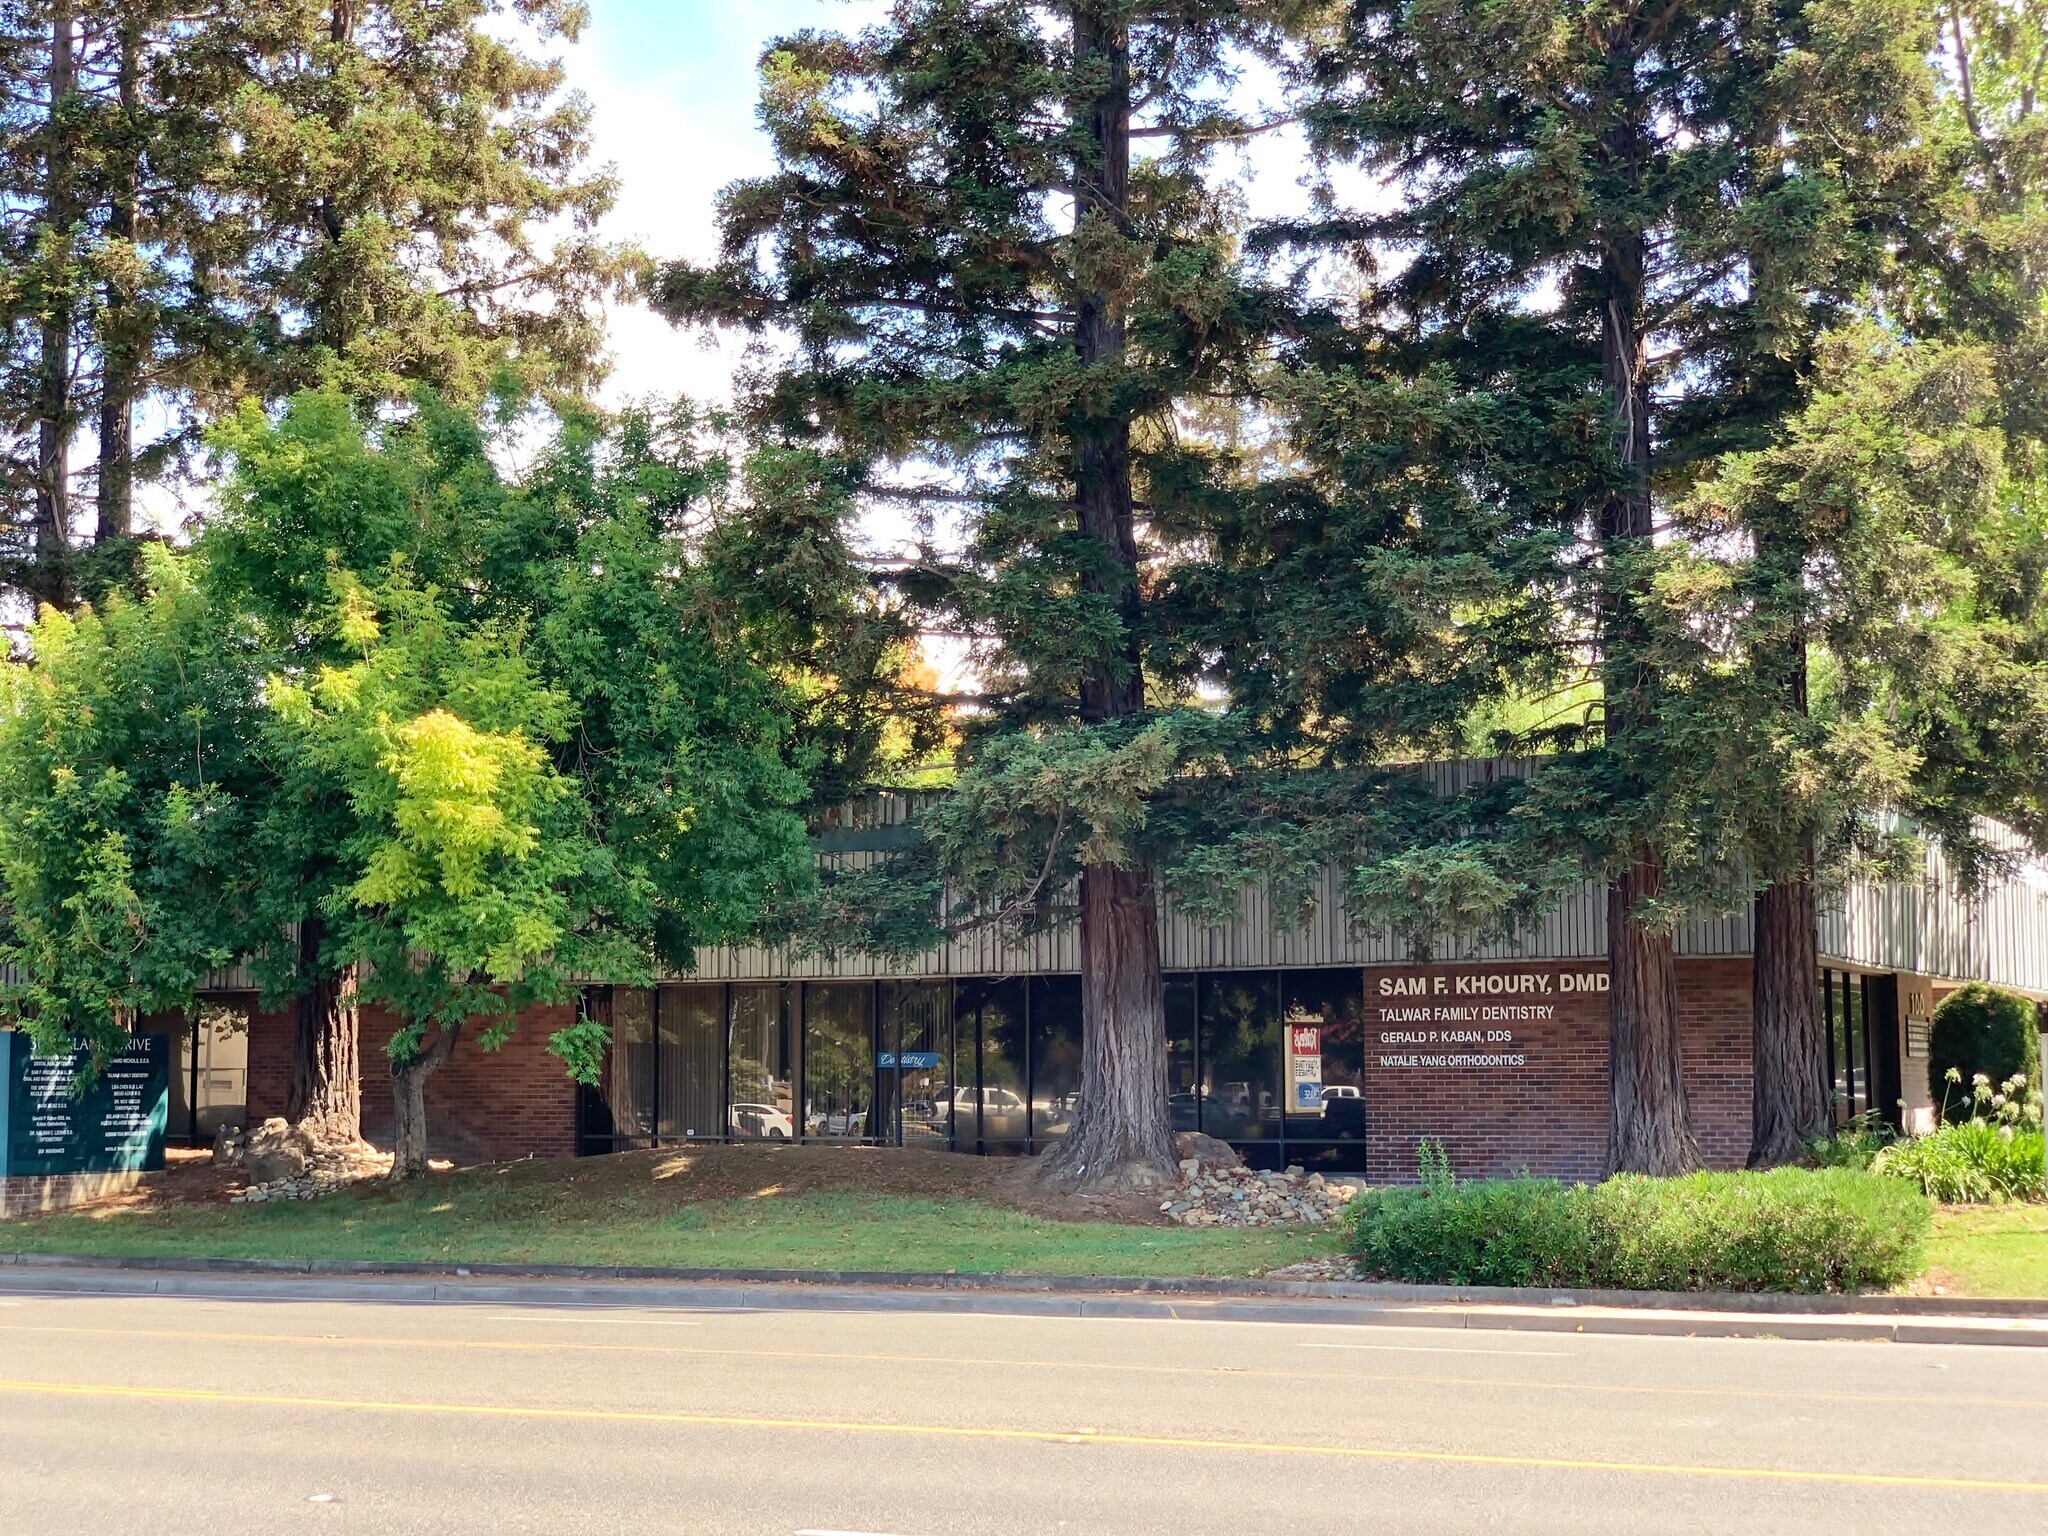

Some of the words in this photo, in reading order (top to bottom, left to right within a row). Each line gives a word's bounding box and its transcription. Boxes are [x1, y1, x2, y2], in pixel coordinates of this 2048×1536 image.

[1379, 977, 1426, 996] SAM
[1434, 977, 1449, 995] F.
[1456, 974, 1552, 996] KHOURY,
[1560, 973, 1610, 993] DMD
[1911, 992, 1925, 1015] 100
[1379, 1008, 1431, 1022] TALWAR
[1434, 1007, 1479, 1022] FAMILY
[1482, 1006, 1554, 1021] DENTISTRY
[1381, 1032, 1427, 1043] GERALD
[1429, 1031, 1439, 1043] P.
[1441, 1031, 1485, 1044] KABAN,
[1487, 1030, 1512, 1042] DDS
[880, 1054, 925, 1068] Detistry
[1380, 1056, 1418, 1067] NATALIE
[1420, 1055, 1447, 1066] YANG
[1447, 1055, 1525, 1066] ORTHODONTICS
